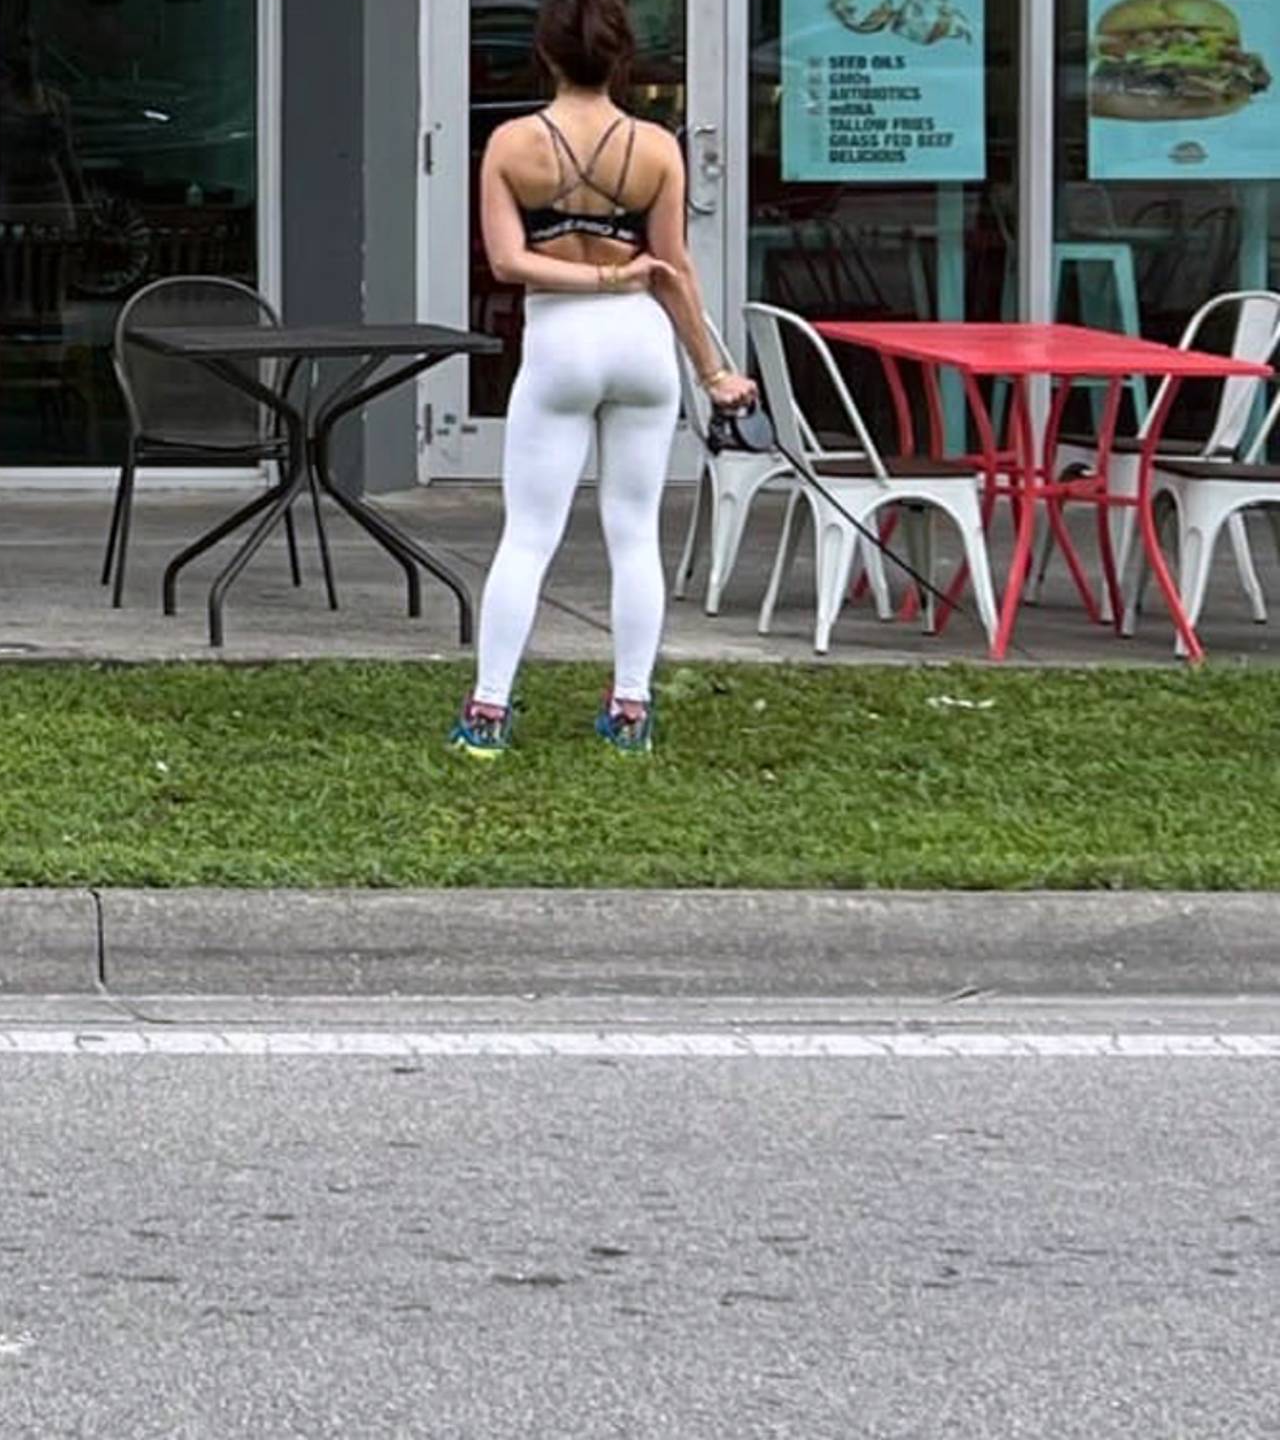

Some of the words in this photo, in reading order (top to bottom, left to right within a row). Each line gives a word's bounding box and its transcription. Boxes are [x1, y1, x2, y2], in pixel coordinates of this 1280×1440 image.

[828, 117, 888, 132] TALLOW
[892, 117, 936, 132] FRIES
[828, 133, 880, 148] GRASS
[884, 133, 913, 148] FED
[916, 132, 955, 148] BEEF
[828, 149, 907, 163] DELICIOUS
